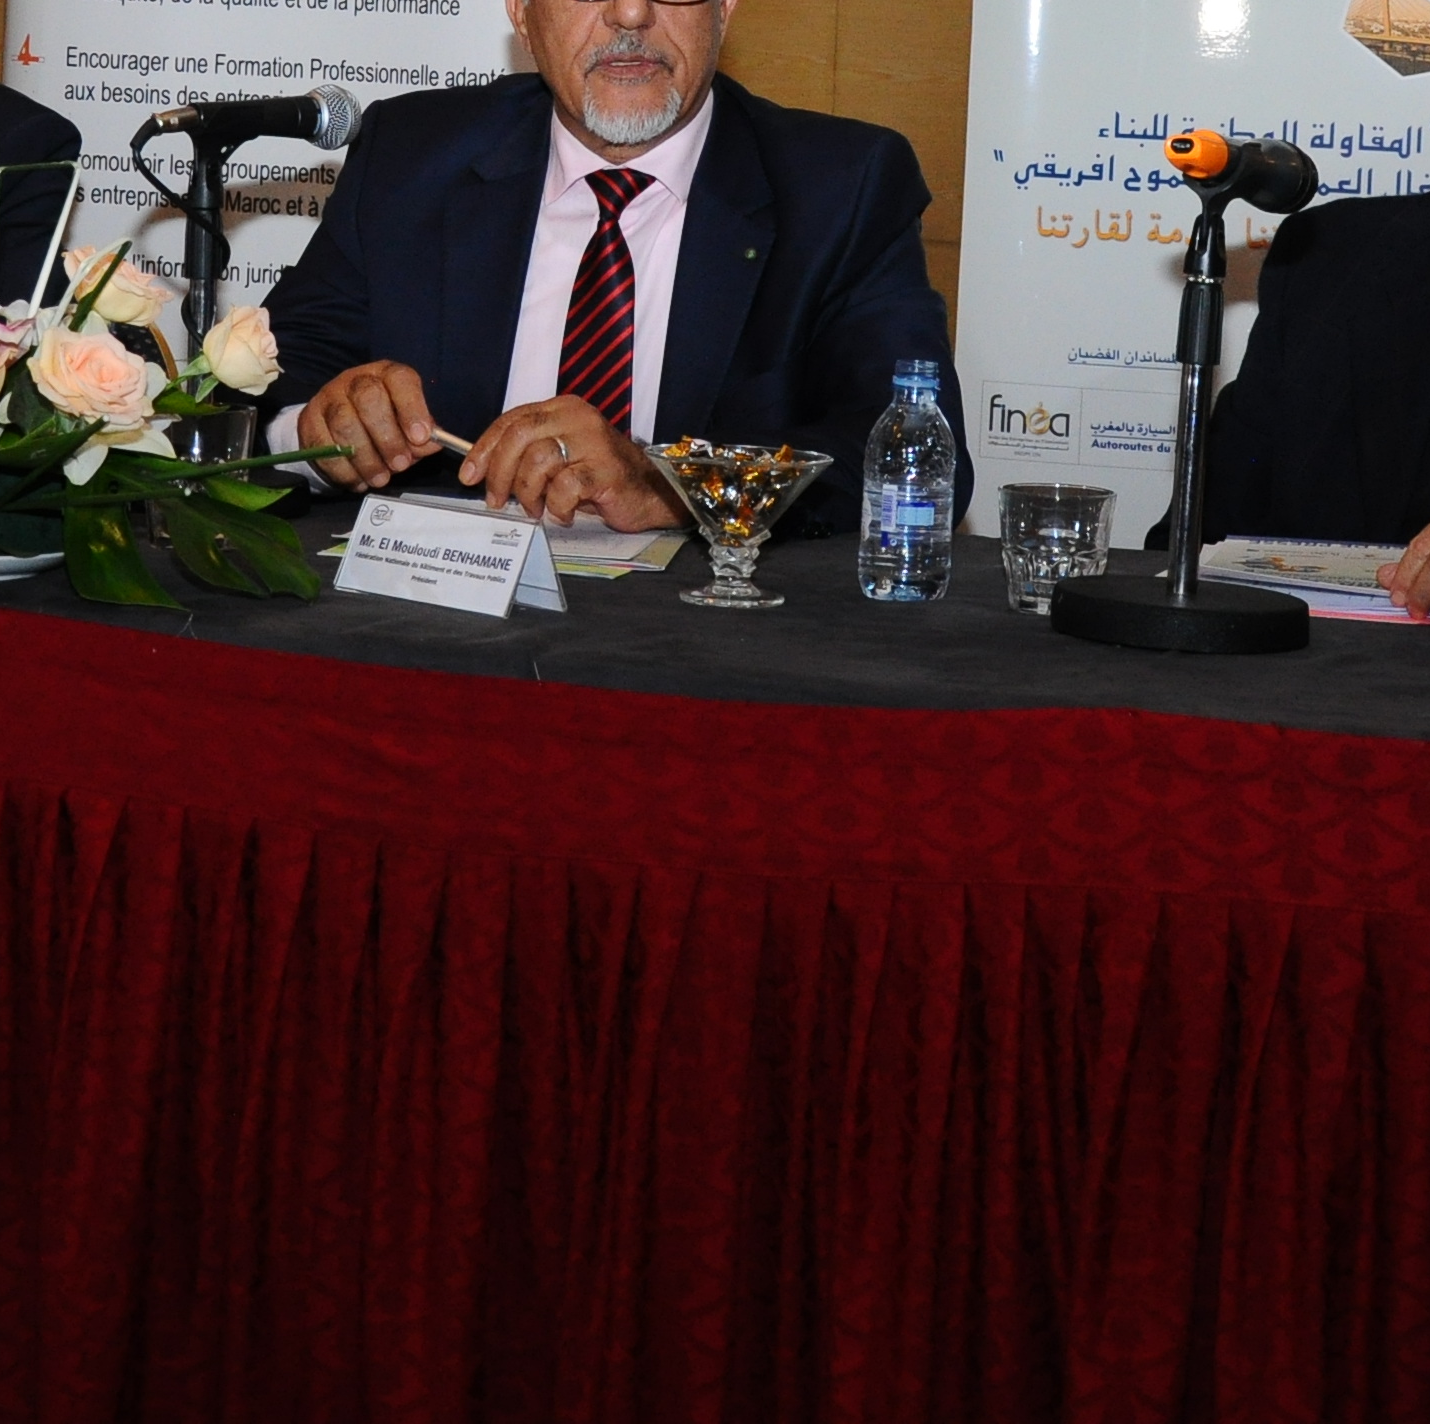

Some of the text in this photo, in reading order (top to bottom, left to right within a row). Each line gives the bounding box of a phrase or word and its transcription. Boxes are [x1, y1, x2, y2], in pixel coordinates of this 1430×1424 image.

[66, 45, 505, 87] Encourager une Formation Professionnelle adapt
[64, 84, 96, 102] aux
[101, 82, 171, 104] besoins
[176, 85, 212, 104] des
[1098, 111, 1169, 148] للبناء
[170, 154, 193, 176] les
[225, 195, 319, 216] Maroc et à
[1036, 206, 1133, 248] لقارتنا
[1091, 439, 1171, 453] Autoroutes du
[359, 533, 375, 548] Mr.
[378, 537, 390, 550] El
[442, 548, 513, 571] BENHAMANE
